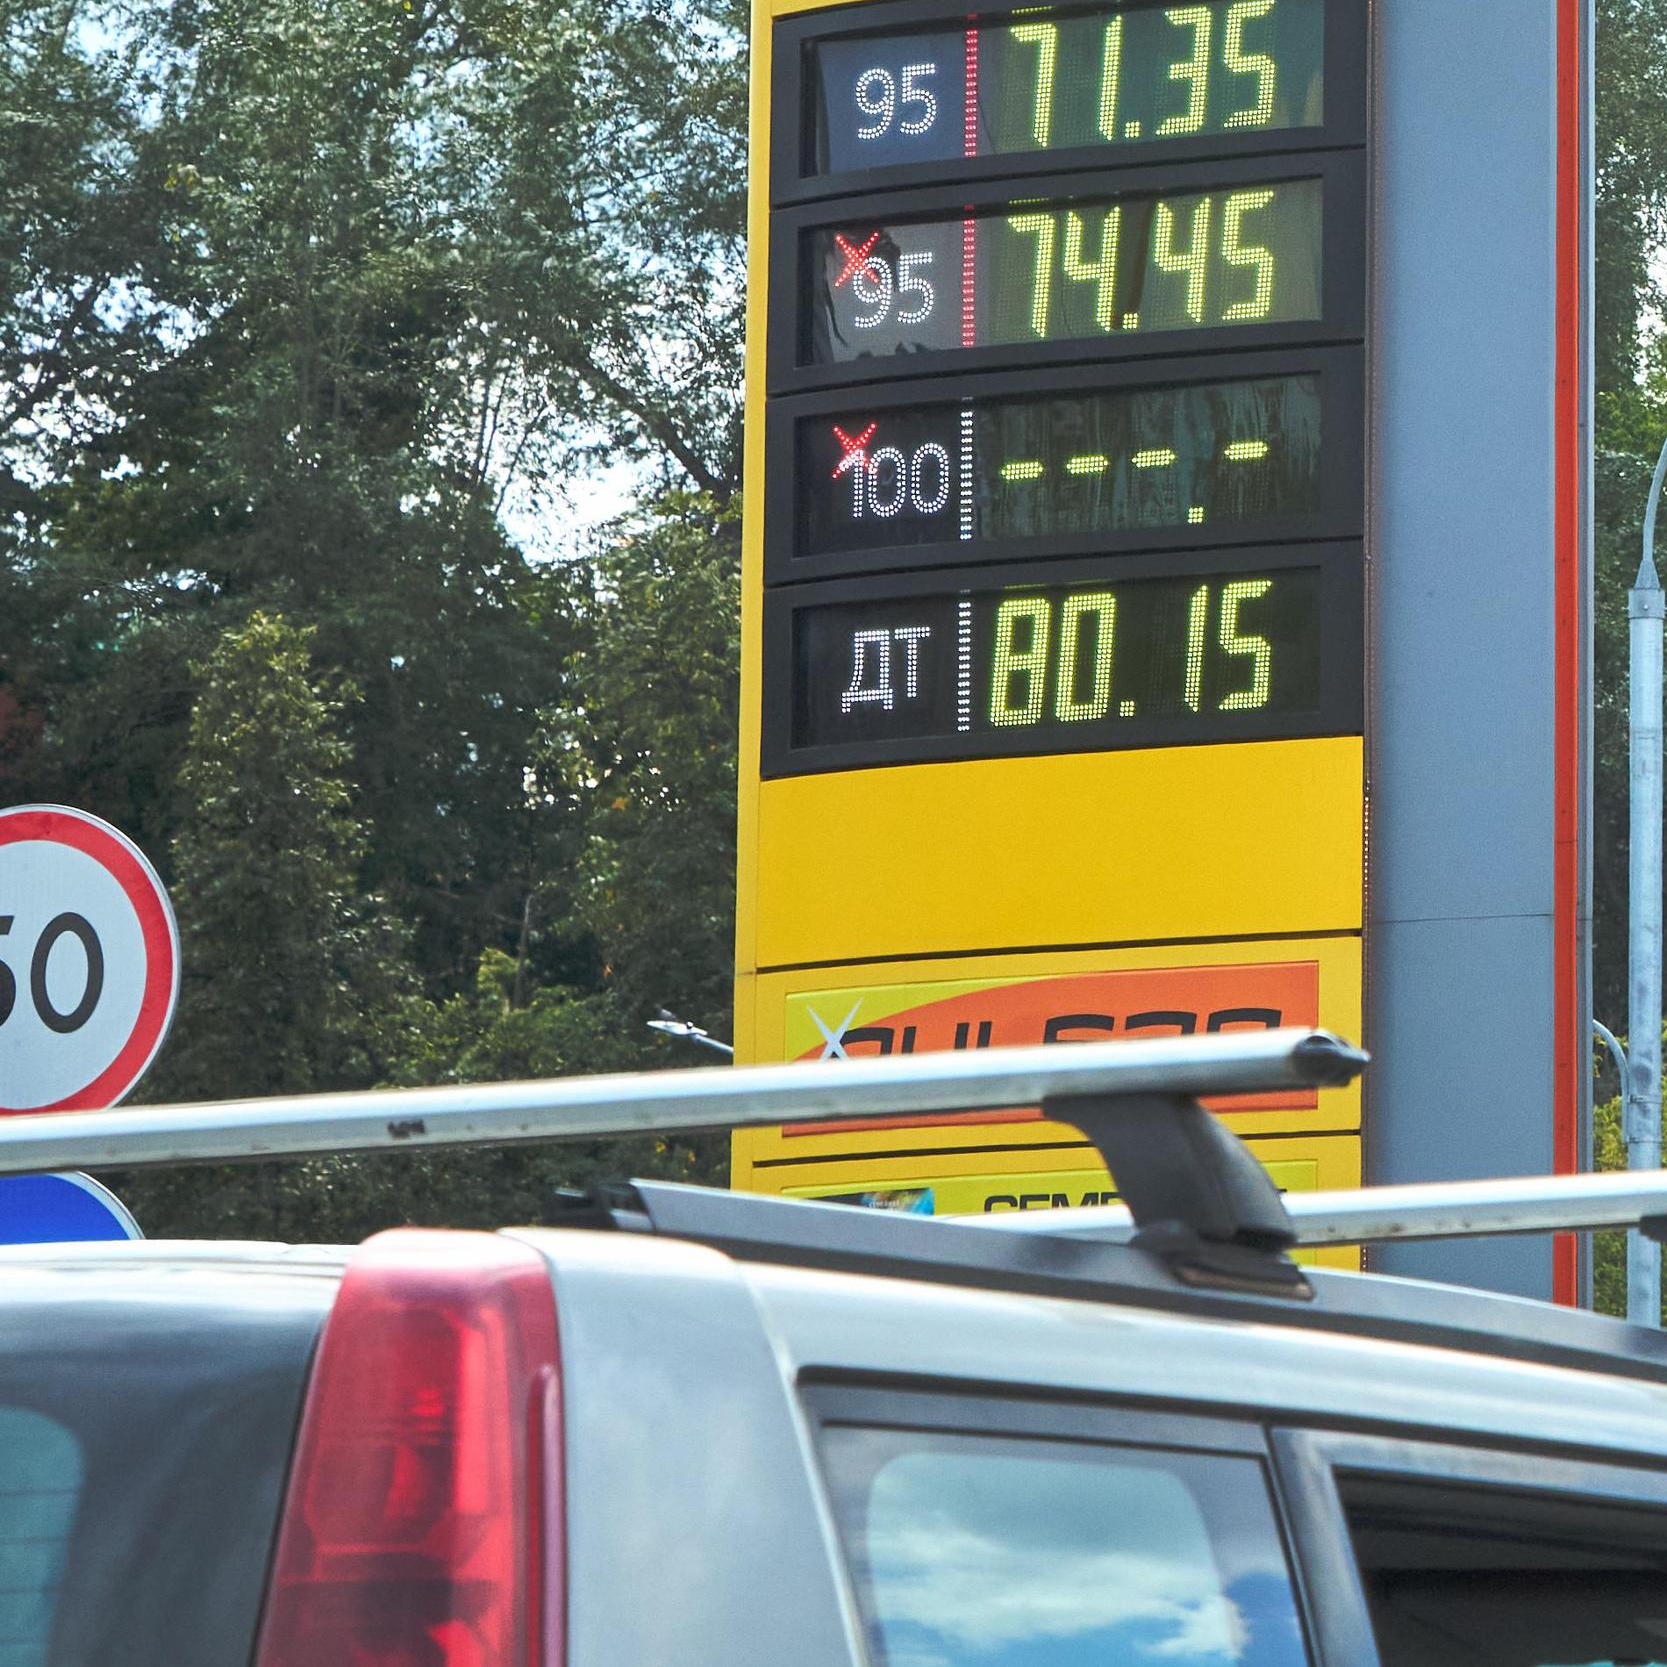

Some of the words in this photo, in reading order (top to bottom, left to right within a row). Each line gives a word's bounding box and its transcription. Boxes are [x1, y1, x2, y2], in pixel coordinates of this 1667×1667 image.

[853, 63, 937, 141] 95
[853, 250, 935, 329] 95
[1007, 190, 1276, 338] 74.45
[839, 442, 950, 518] 100
[840, 625, 931, 714] ДТ
[989, 580, 1273, 727] 80.15
[0, 911, 105, 1034] 0
